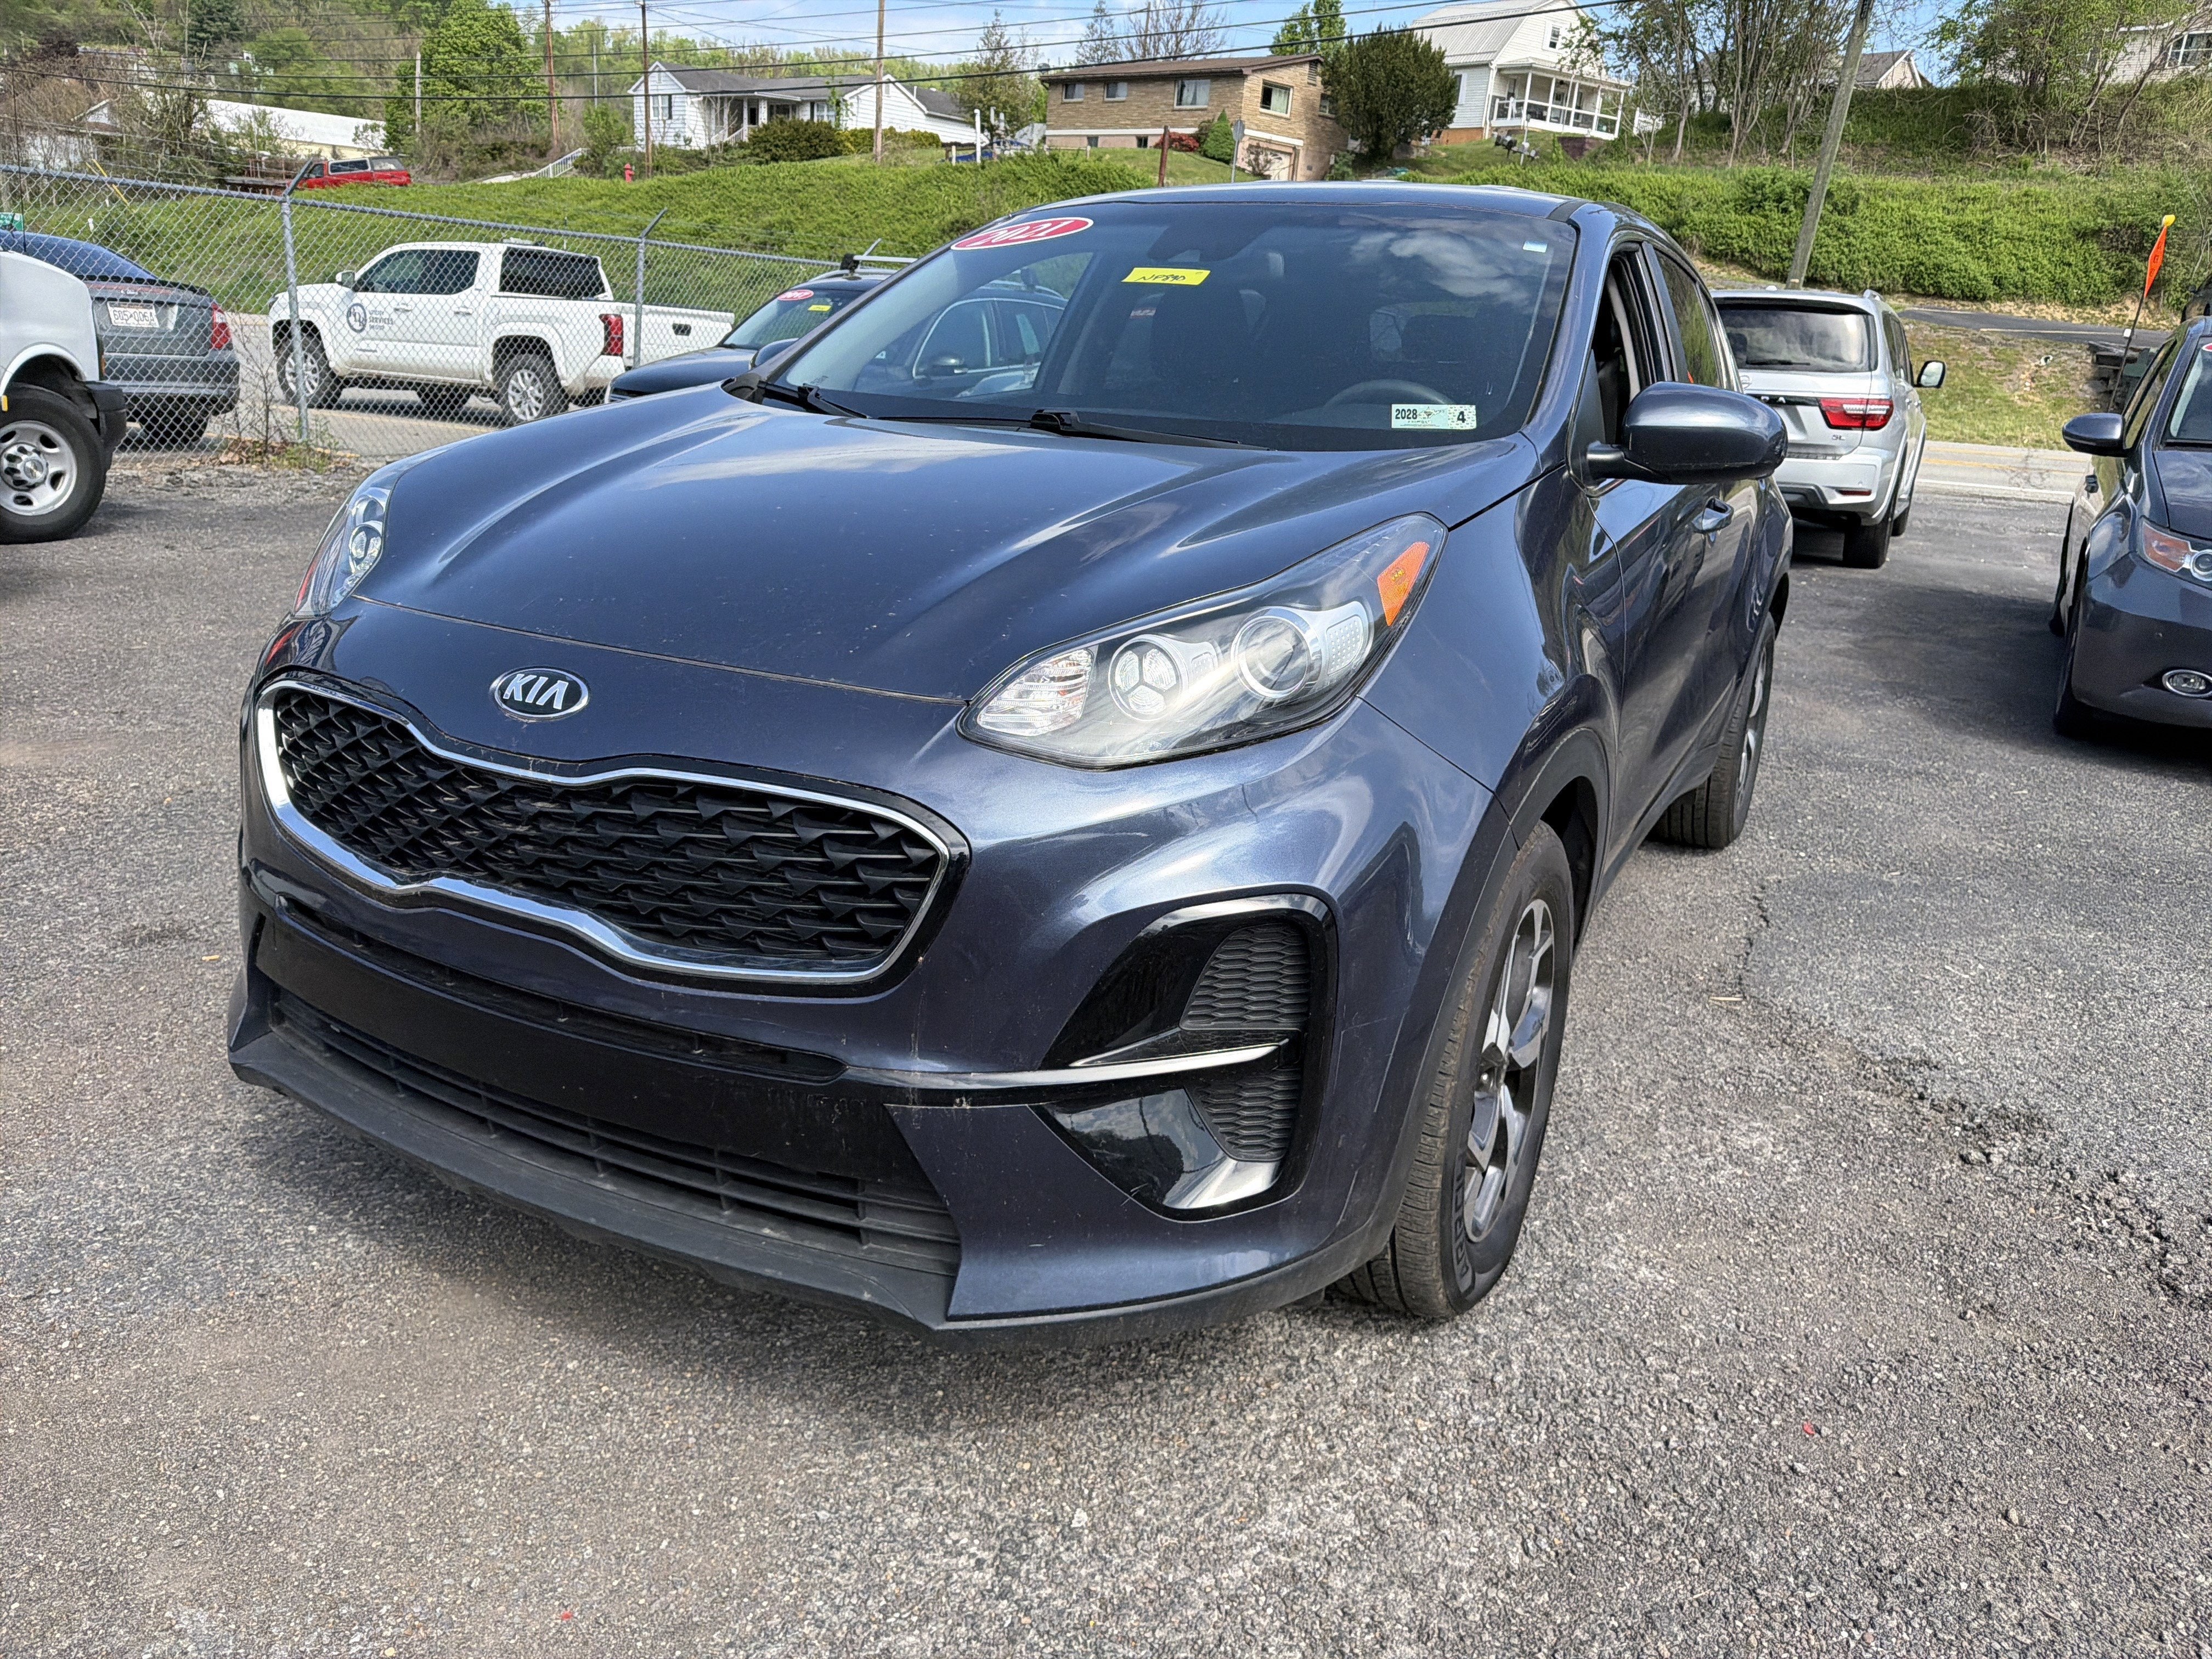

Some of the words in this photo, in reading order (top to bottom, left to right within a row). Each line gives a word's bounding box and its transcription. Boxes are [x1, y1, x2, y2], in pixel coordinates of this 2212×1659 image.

[1395, 408, 1418, 420] 2028
[1457, 411, 1466, 424] 4
[503, 674, 569, 709] KIA
